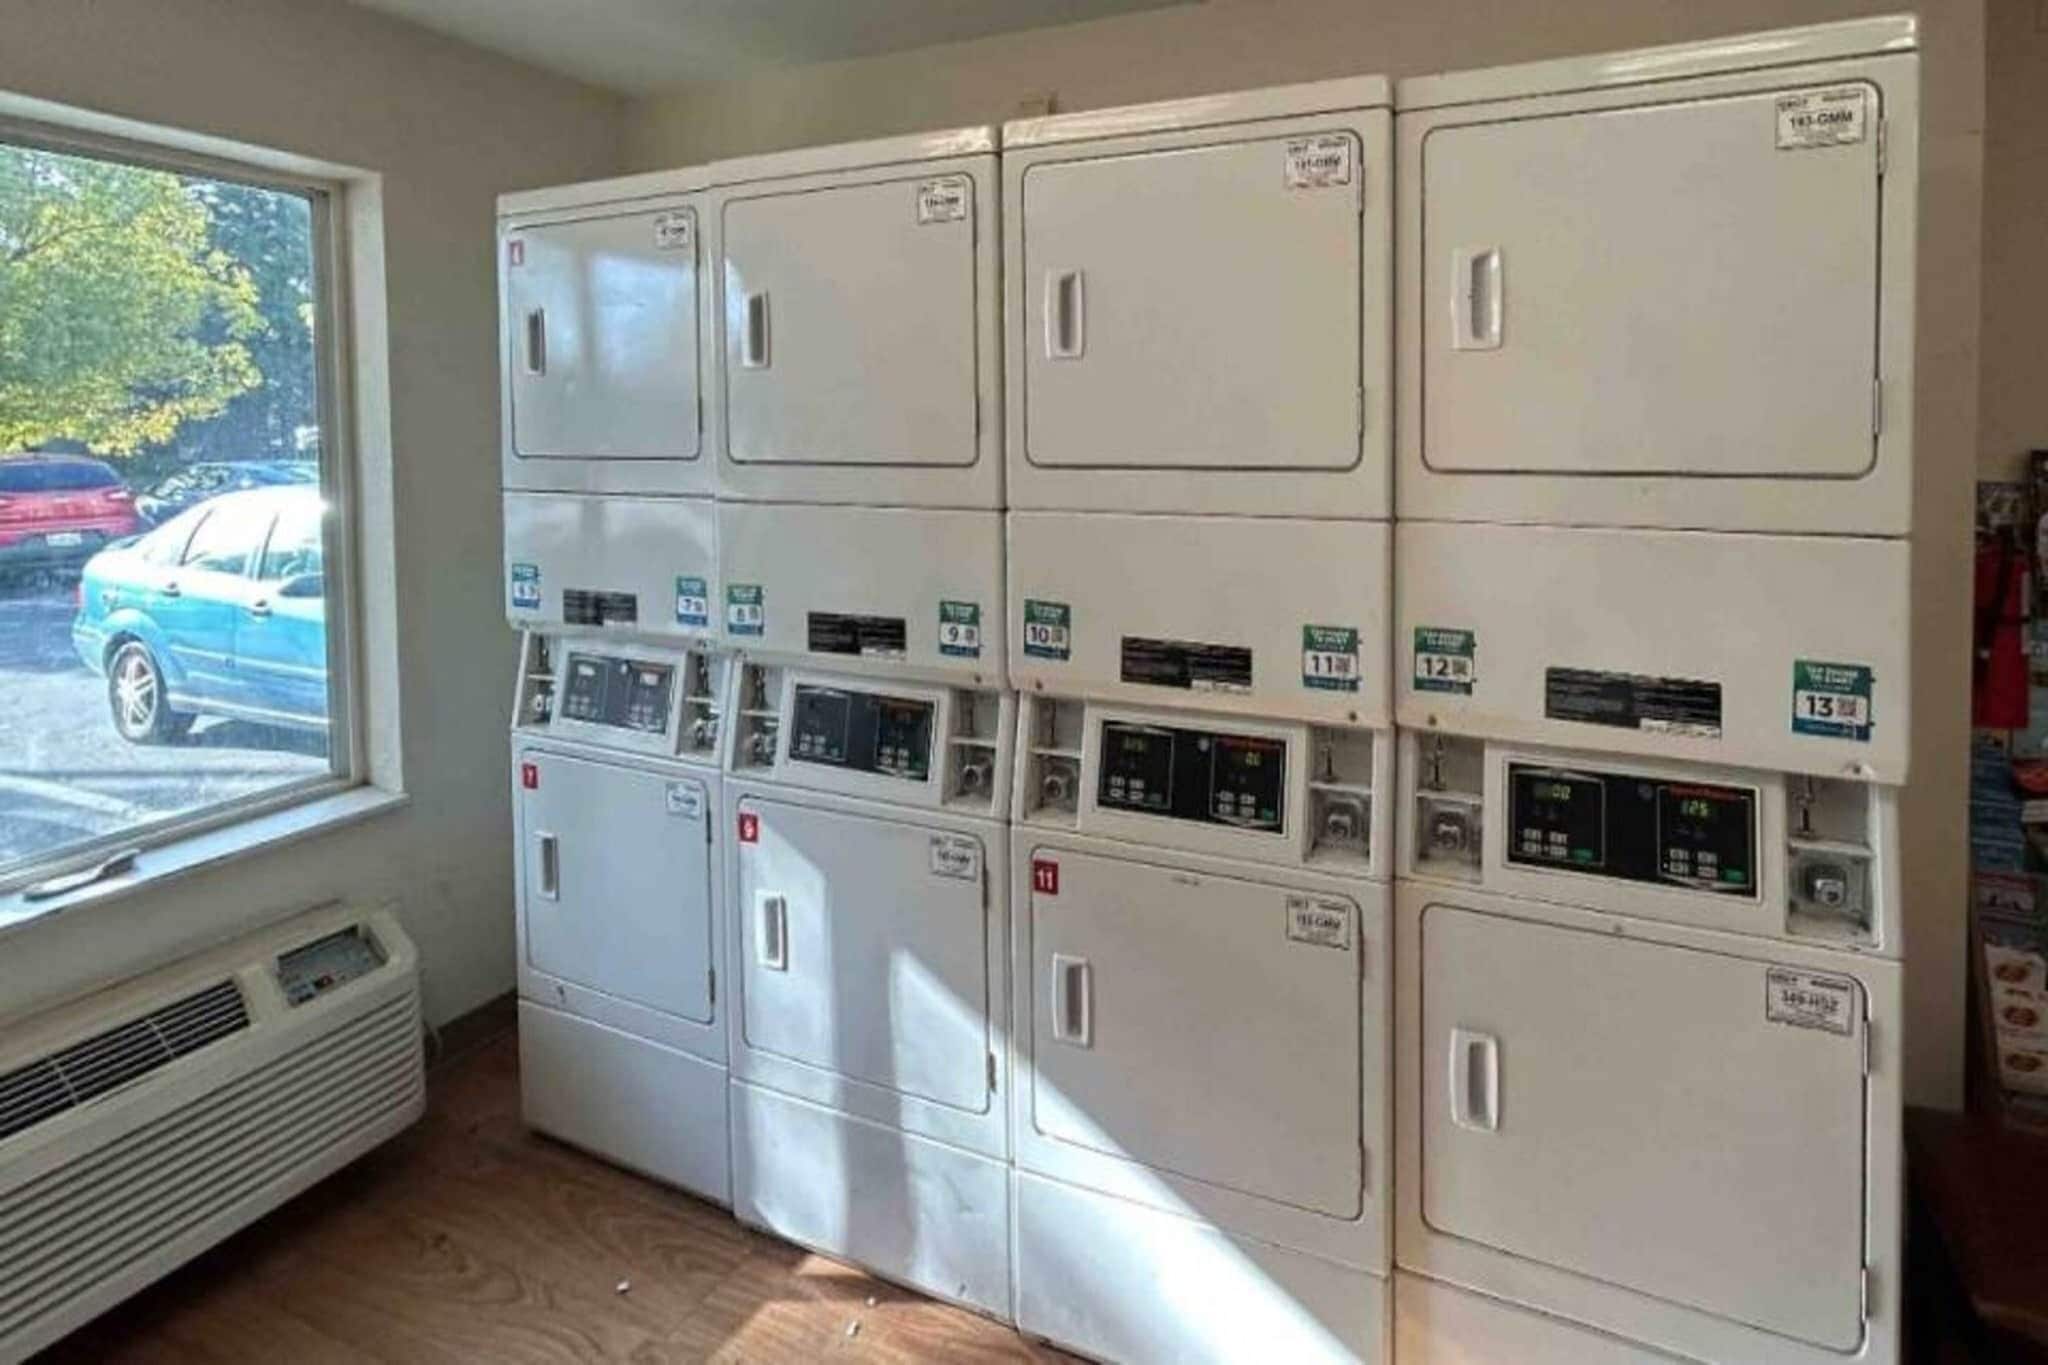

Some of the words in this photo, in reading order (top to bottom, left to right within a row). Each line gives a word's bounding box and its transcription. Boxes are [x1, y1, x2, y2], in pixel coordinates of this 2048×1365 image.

[949, 626, 959, 642] 9
[1030, 626, 1049, 643] 10
[1312, 655, 1333, 673] 11
[1425, 657, 1448, 676] 12
[1807, 695, 1833, 717] 13
[1037, 869, 1053, 890] 11
